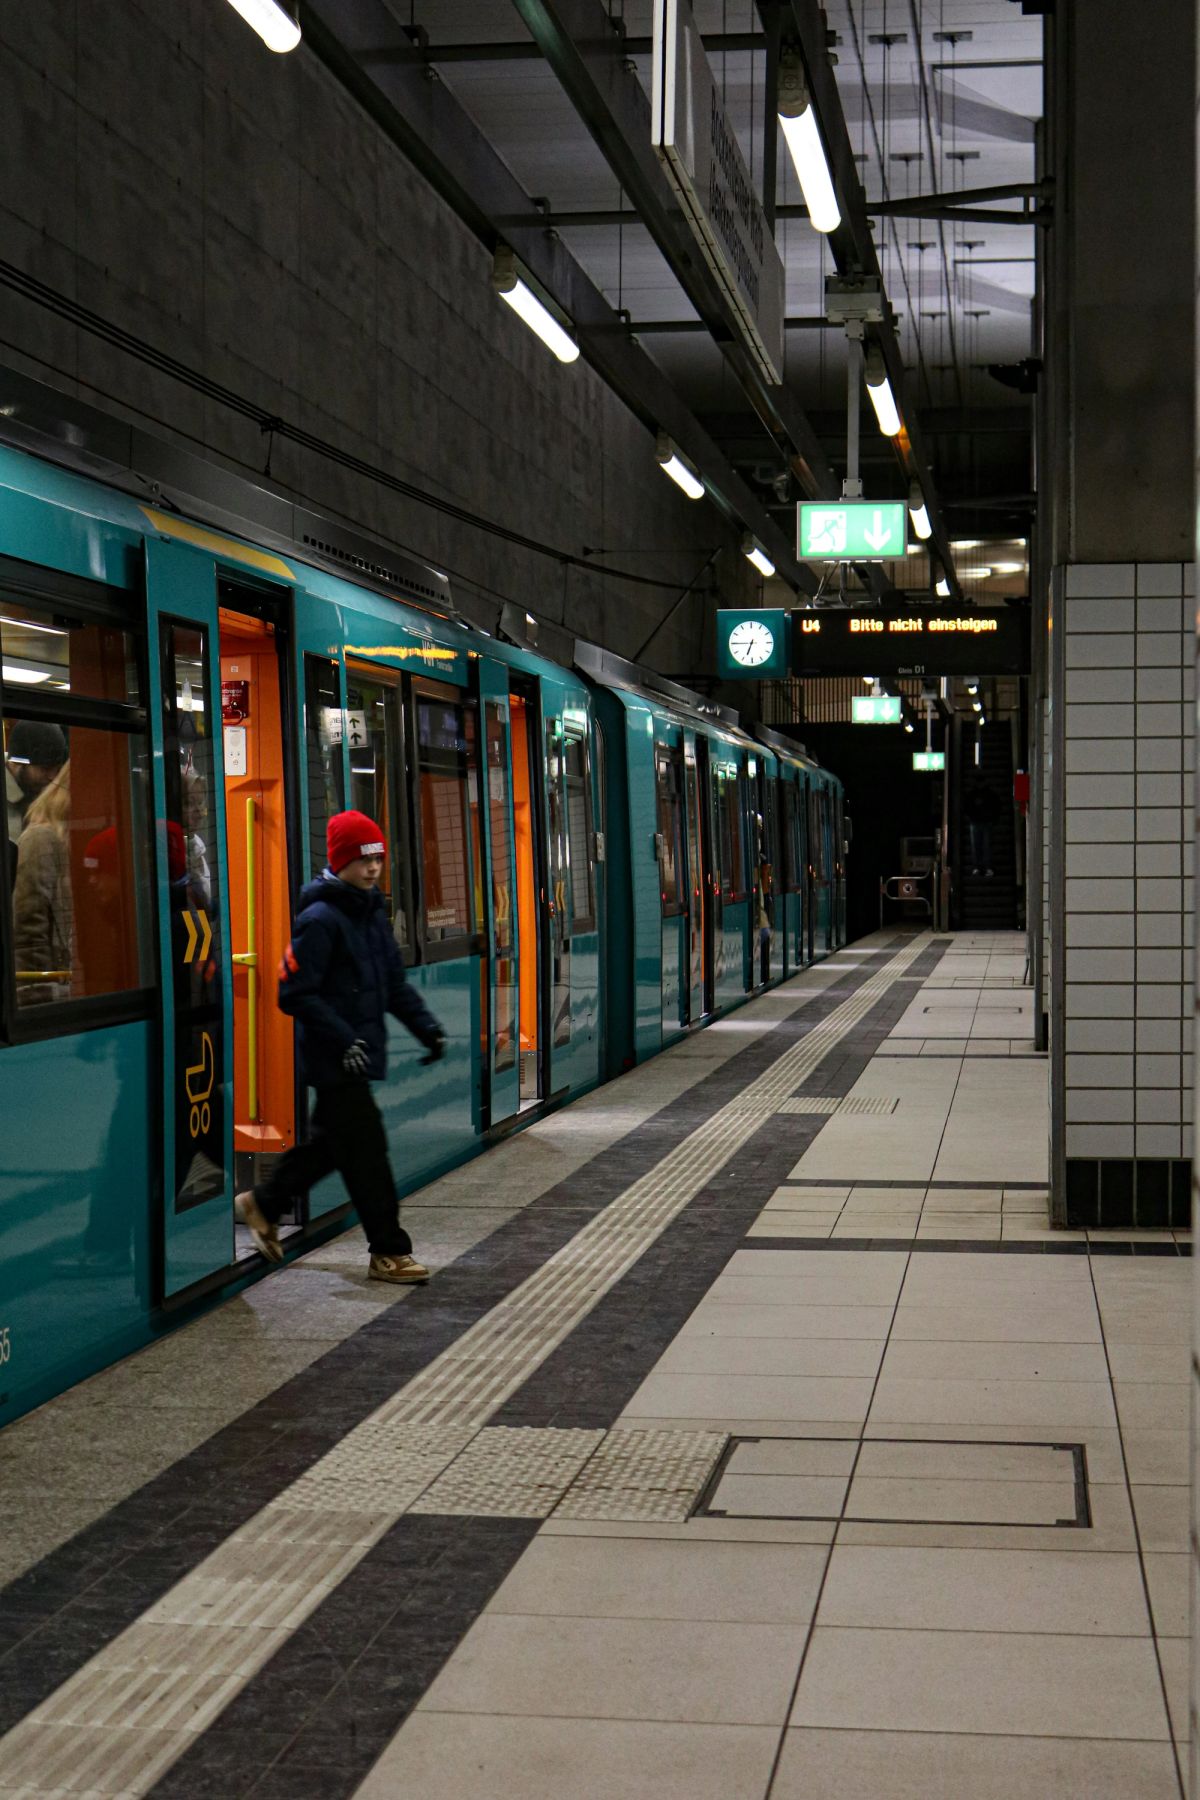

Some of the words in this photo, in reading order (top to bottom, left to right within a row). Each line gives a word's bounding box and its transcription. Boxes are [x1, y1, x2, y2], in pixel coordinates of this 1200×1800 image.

[802, 619, 820, 632] U4
[850, 619, 884, 632] Bitte
[889, 619, 923, 631] nicht
[928, 618, 997, 633] einsteigen
